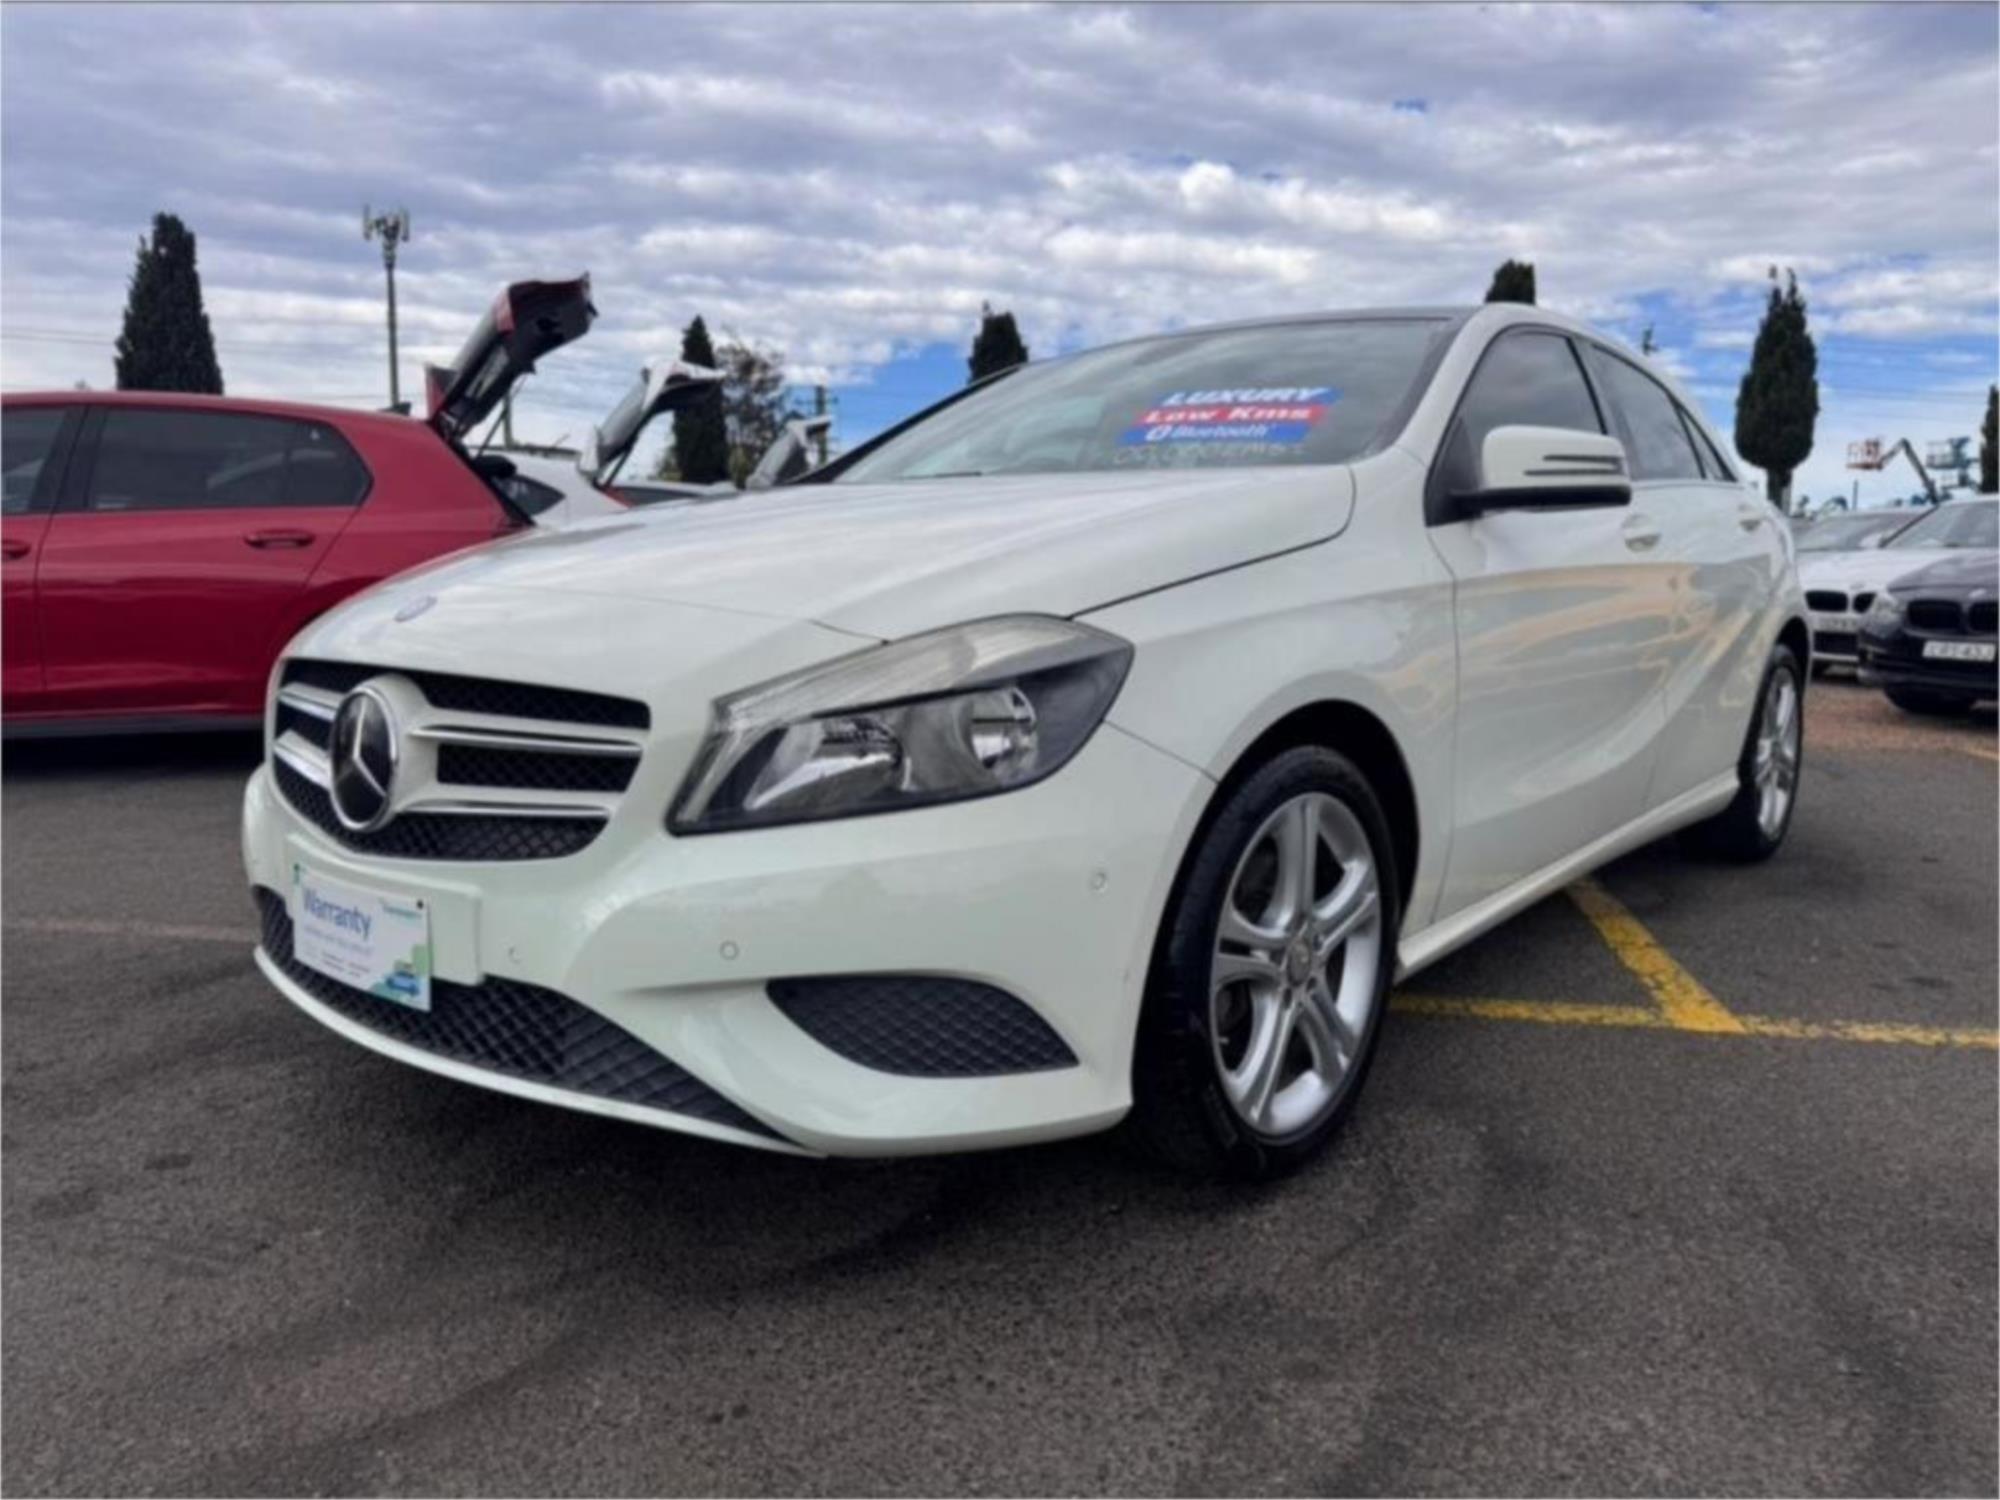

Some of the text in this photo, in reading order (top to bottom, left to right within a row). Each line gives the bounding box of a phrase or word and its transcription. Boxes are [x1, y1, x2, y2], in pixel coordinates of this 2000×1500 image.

[1162, 387, 1331, 407] LUXURY
[1143, 405, 1312, 424] Low Kms
[303, 887, 372, 941] Warranty
